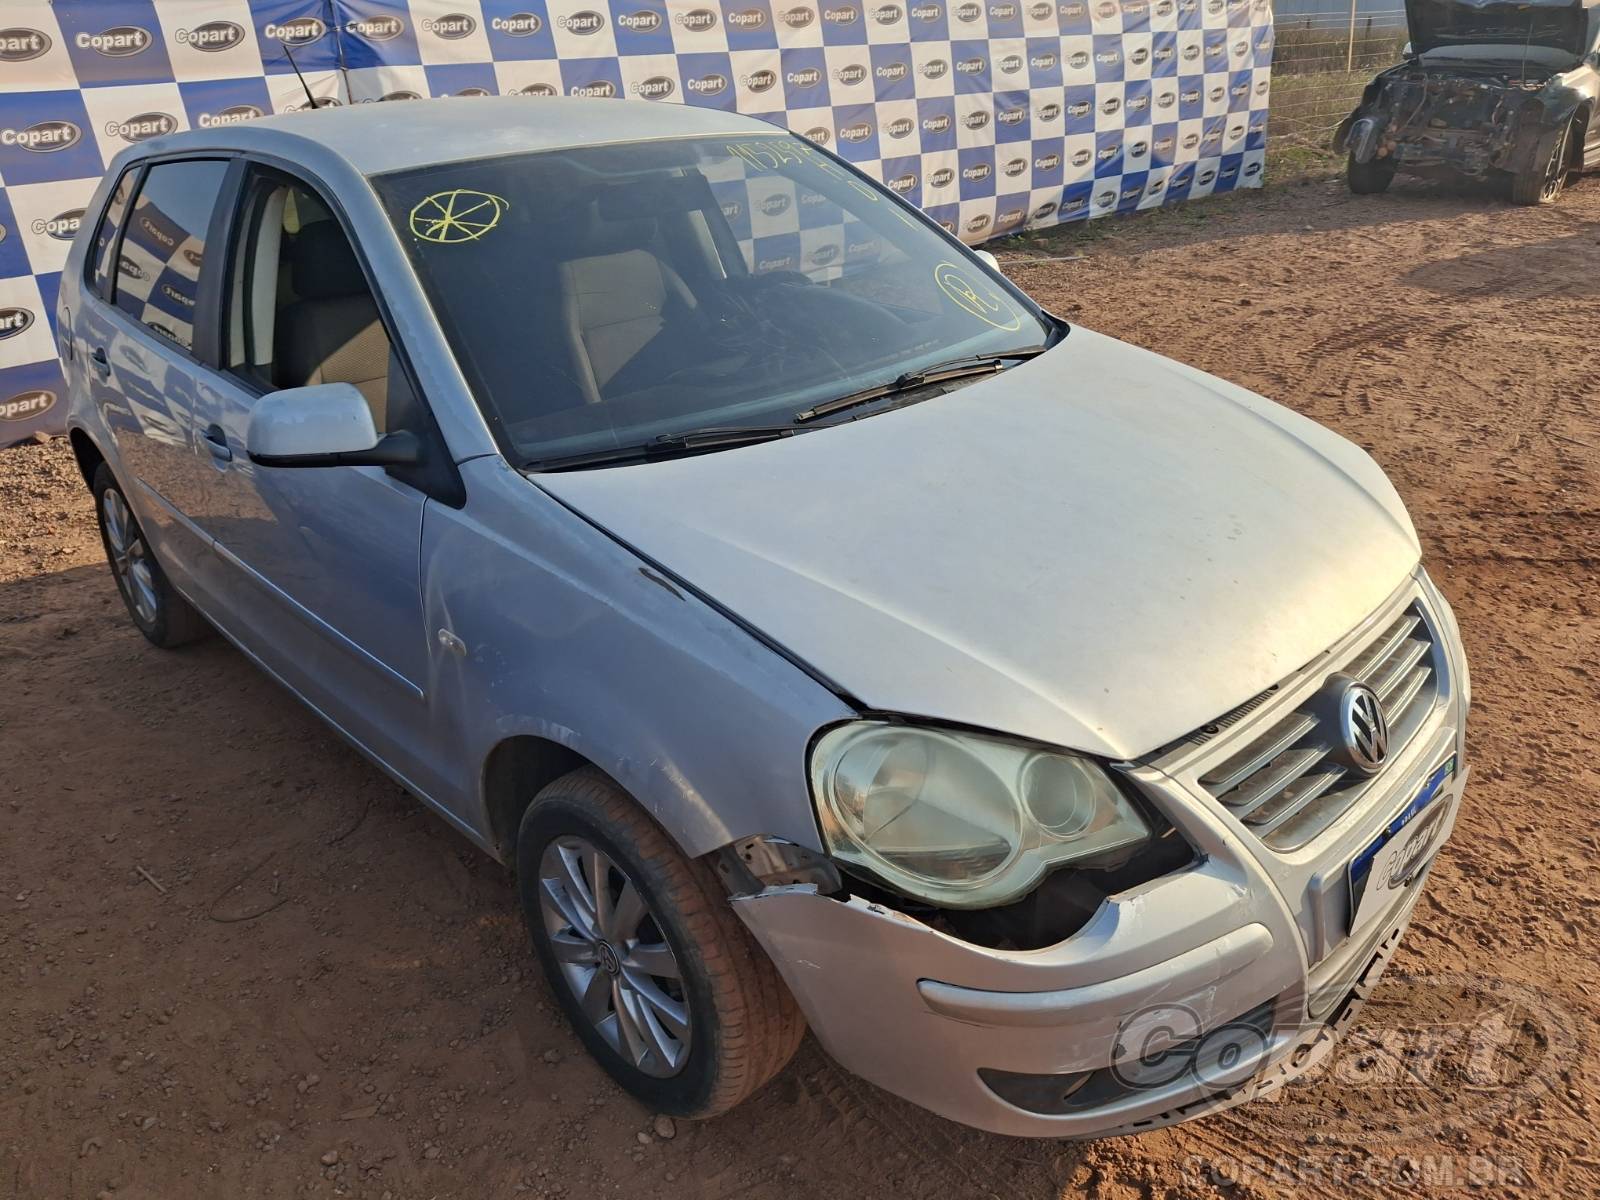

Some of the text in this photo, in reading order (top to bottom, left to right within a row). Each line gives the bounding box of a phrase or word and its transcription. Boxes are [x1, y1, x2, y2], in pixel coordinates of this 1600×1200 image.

[728, 11, 762, 25] Copart
[778, 9, 810, 23] Copart
[825, 8, 854, 22] Copart
[870, 7, 898, 20] Copart
[912, 7, 939, 20] Copart
[990, 6, 1014, 17] Copart
[422, 18, 469, 33] Copart
[491, 17, 536, 32] Copart
[557, 15, 599, 30] Copart
[618, 13, 657, 28] Copart
[675, 12, 711, 27] Copart
[265, 22, 319, 39] Copart
[346, 20, 398, 35] Copart
[0, 33, 41, 51] part
[76, 26, 142, 51] Copart
[175, 26, 236, 45] Copart
[957, 59, 982, 73] Copart
[1031, 55, 1054, 68] Copart
[787, 70, 818, 84] Copart
[876, 65, 905, 78] Copart
[631, 79, 669, 95] Copart
[687, 76, 723, 91] Copart
[740, 73, 772, 90] Copart
[570, 83, 611, 97] Copart
[999, 109, 1024, 122] Copart
[105, 117, 168, 139] Copart
[882, 120, 910, 134] opart
[923, 117, 948, 130] Copart
[1, 124, 71, 147] Copart
[840, 126, 870, 140] Copart
[963, 165, 988, 179] Copart
[888, 176, 914, 190] Copart
[32, 218, 81, 237] Copa
[0, 311, 26, 330] art
[0, 394, 48, 416] opart
